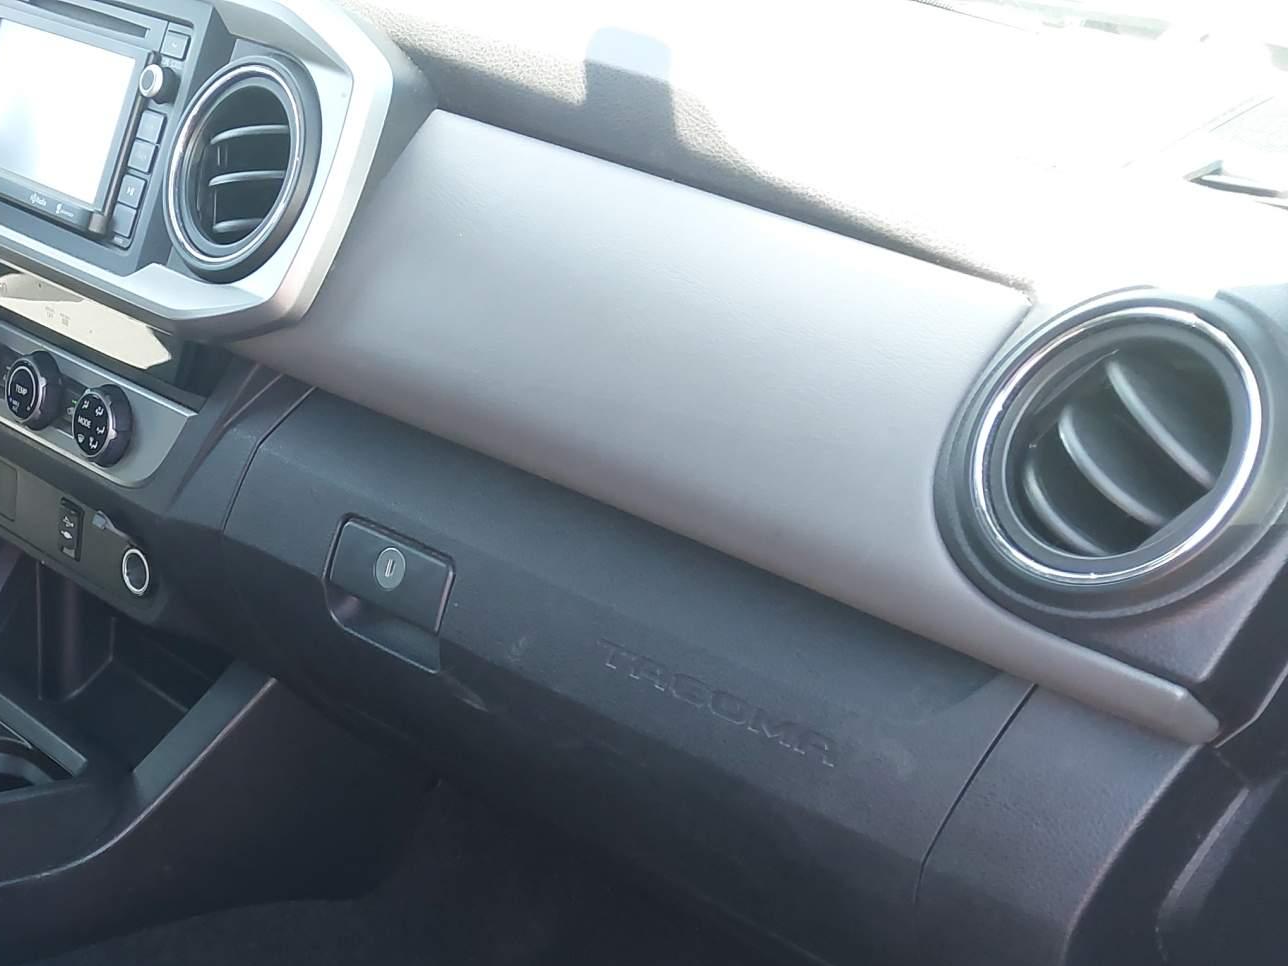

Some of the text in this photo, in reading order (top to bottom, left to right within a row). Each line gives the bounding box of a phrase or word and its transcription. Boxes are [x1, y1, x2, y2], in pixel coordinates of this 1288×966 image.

[15, 383, 28, 396] TEMP
[77, 414, 92, 429] MODE
[594, 637, 836, 769] TACOMA
